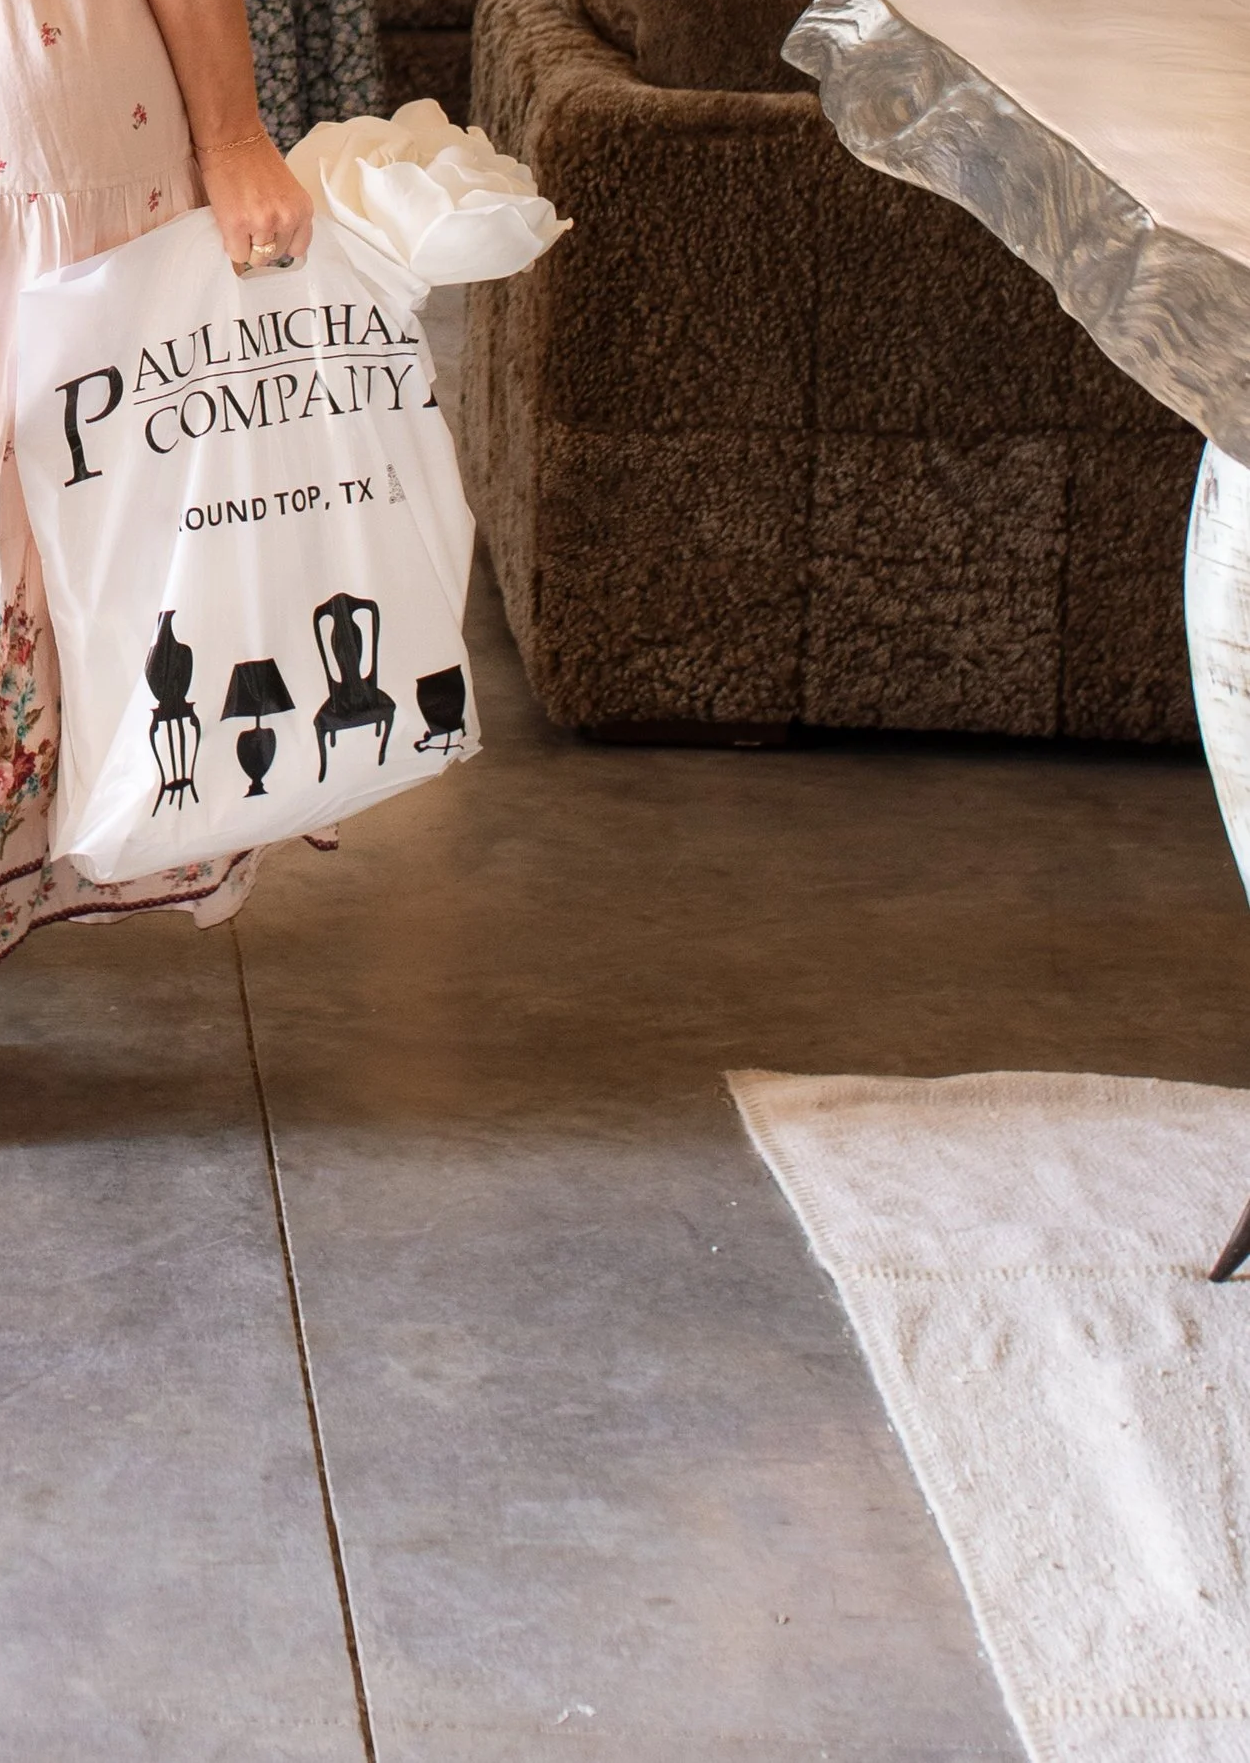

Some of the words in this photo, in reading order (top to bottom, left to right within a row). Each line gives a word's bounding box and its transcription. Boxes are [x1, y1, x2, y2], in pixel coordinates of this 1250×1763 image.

[144, 363, 414, 455] COMPANY
[178, 496, 267, 532] OUND
[273, 485, 331, 516] TOP,
[338, 476, 375, 505] TX
